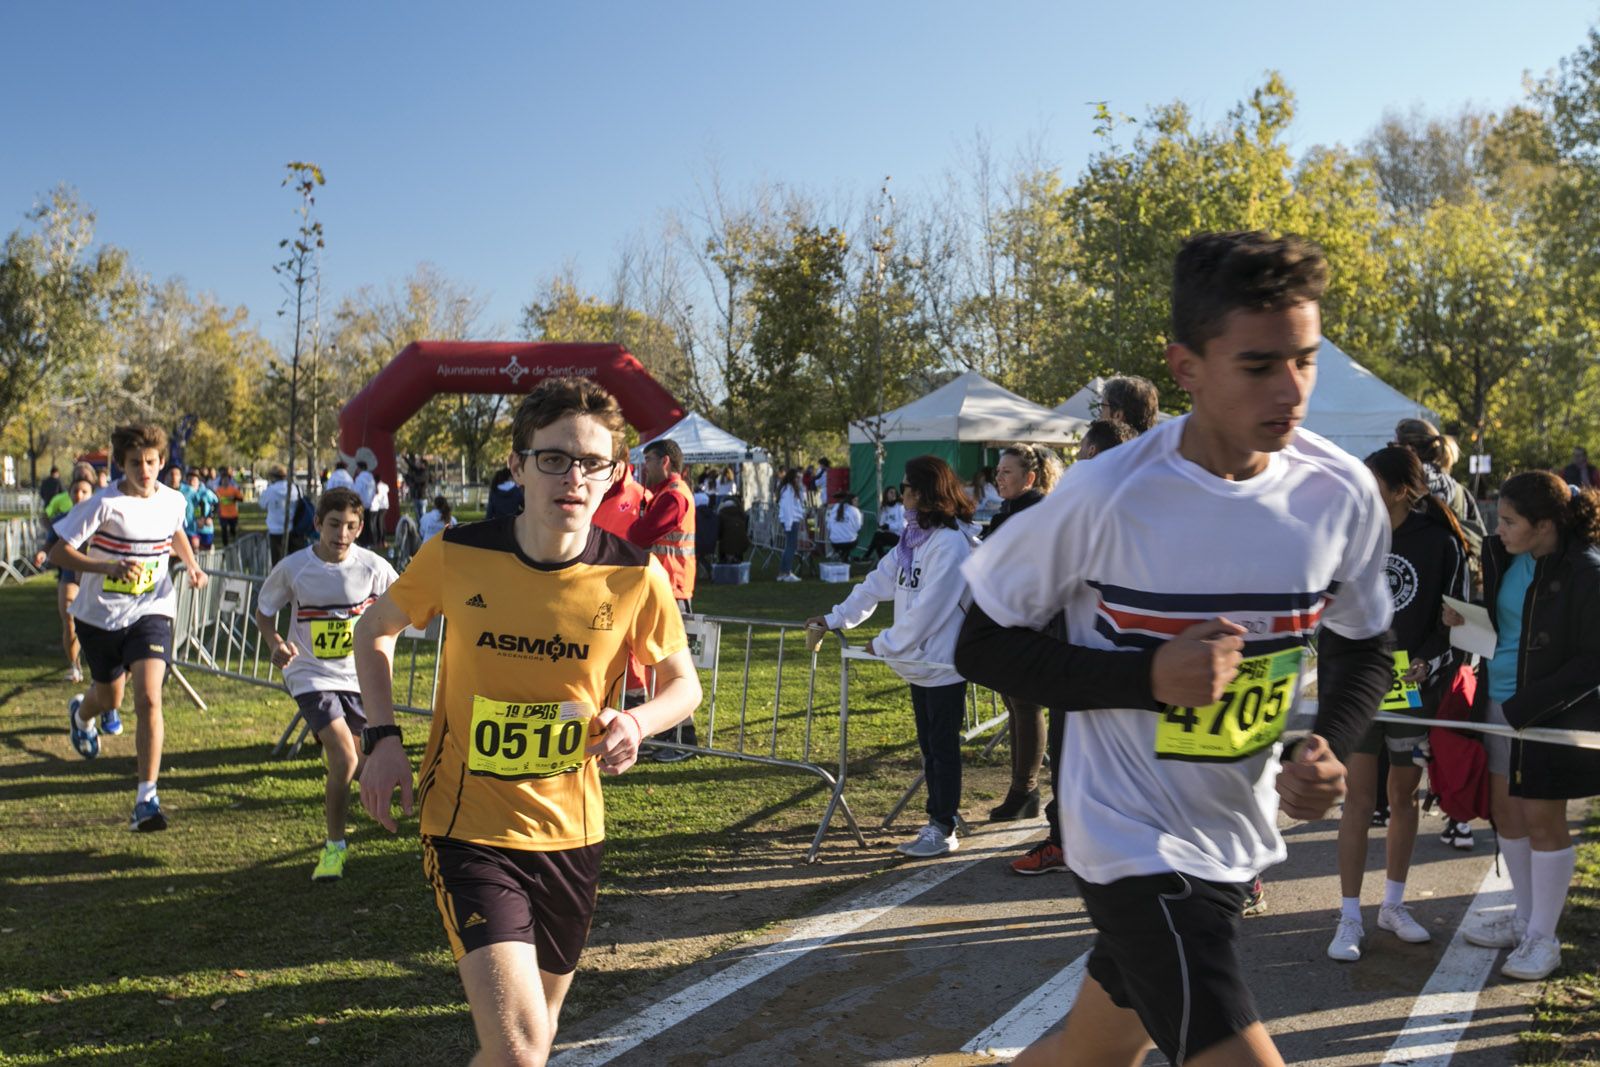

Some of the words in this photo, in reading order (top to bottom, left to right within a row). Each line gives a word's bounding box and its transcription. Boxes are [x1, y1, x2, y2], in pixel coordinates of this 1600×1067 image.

[437, 365, 496, 377] Ajuntament
[532, 365, 545, 376] de
[315, 632, 352, 650] 472
[476, 631, 589, 661] ASMON
[505, 704, 521, 718] 19
[1166, 679, 1288, 735] 4705
[475, 720, 582, 759] 0510
